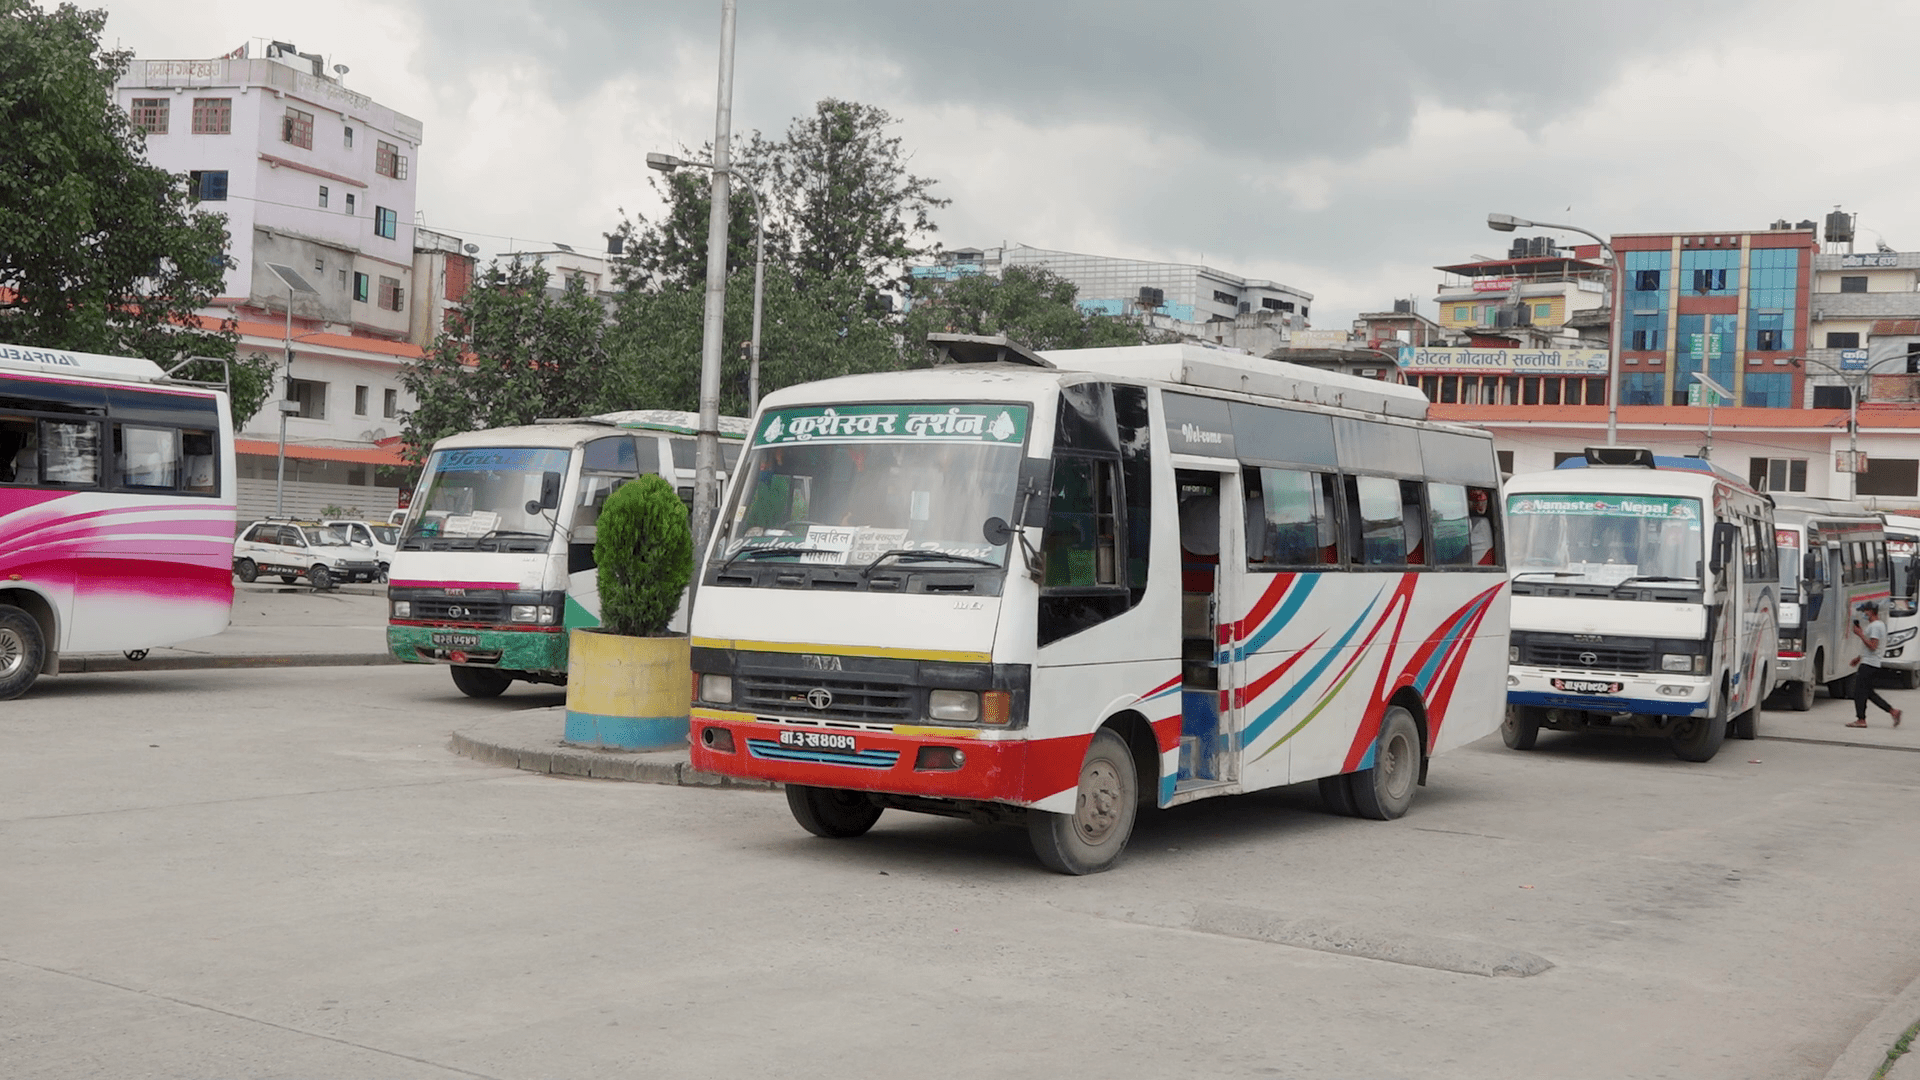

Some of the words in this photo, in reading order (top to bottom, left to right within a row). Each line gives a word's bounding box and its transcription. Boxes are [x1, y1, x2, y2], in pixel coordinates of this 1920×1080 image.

[1416, 349, 1450, 365] होटल
[1456, 350, 1508, 367] गोदावरी
[1512, 350, 1561, 367] सन्तोषी
[788, 408, 898, 441] कुशेस्वर
[904, 407, 987, 438] दर्शन
[1533, 500, 1594, 512] Namaste
[1621, 500, 1668, 514] Nepal
[809, 528, 851, 545] चावहिल
[1573, 634, 1604, 644] TATA
[801, 654, 842, 671] TATA
